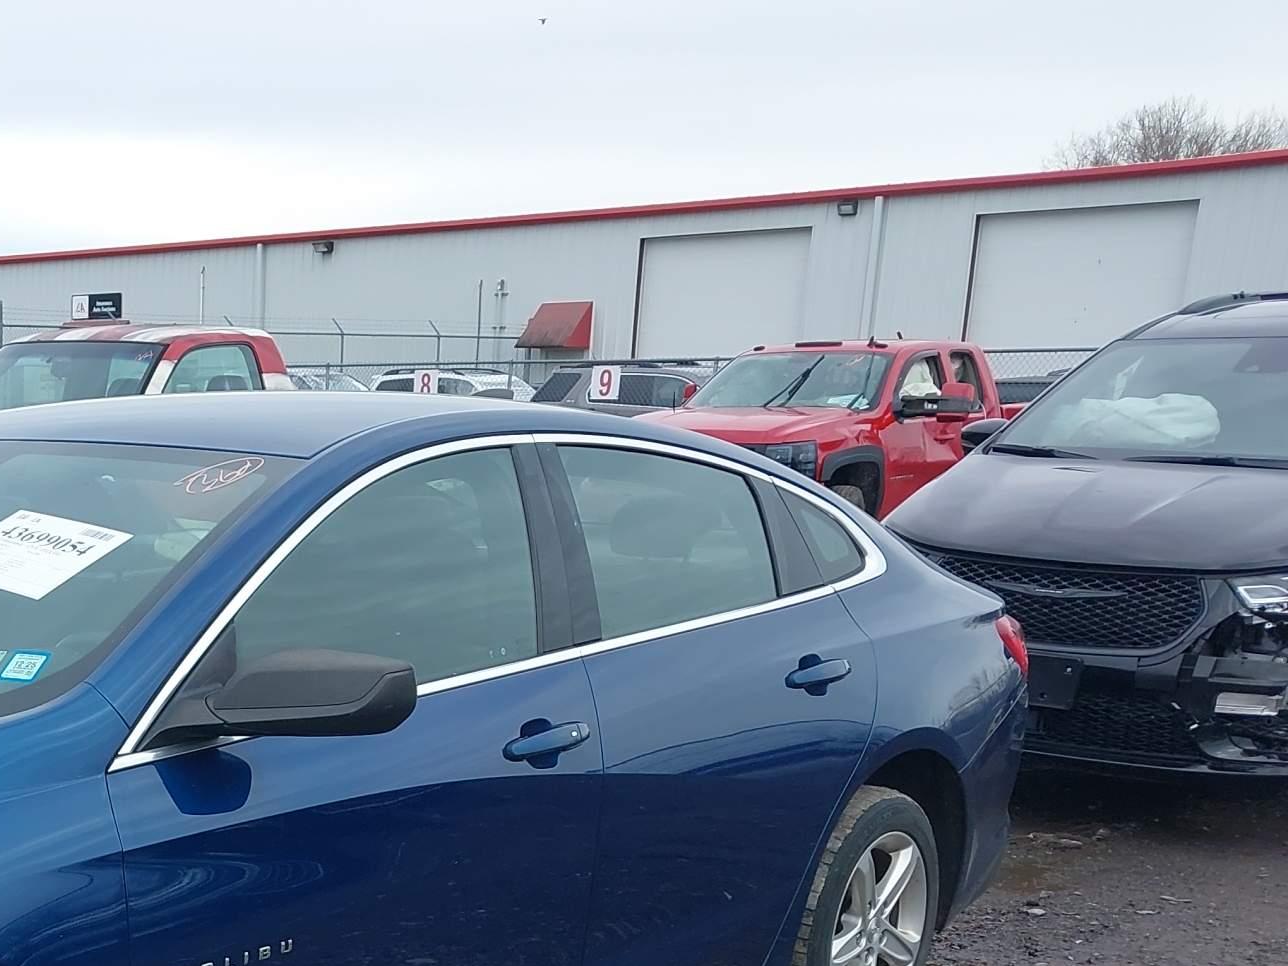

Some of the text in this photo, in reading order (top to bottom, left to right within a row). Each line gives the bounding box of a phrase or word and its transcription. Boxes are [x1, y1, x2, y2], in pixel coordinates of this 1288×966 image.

[420, 373, 431, 393] 8
[598, 369, 612, 396] 9
[1, 526, 96, 556] 43699054
